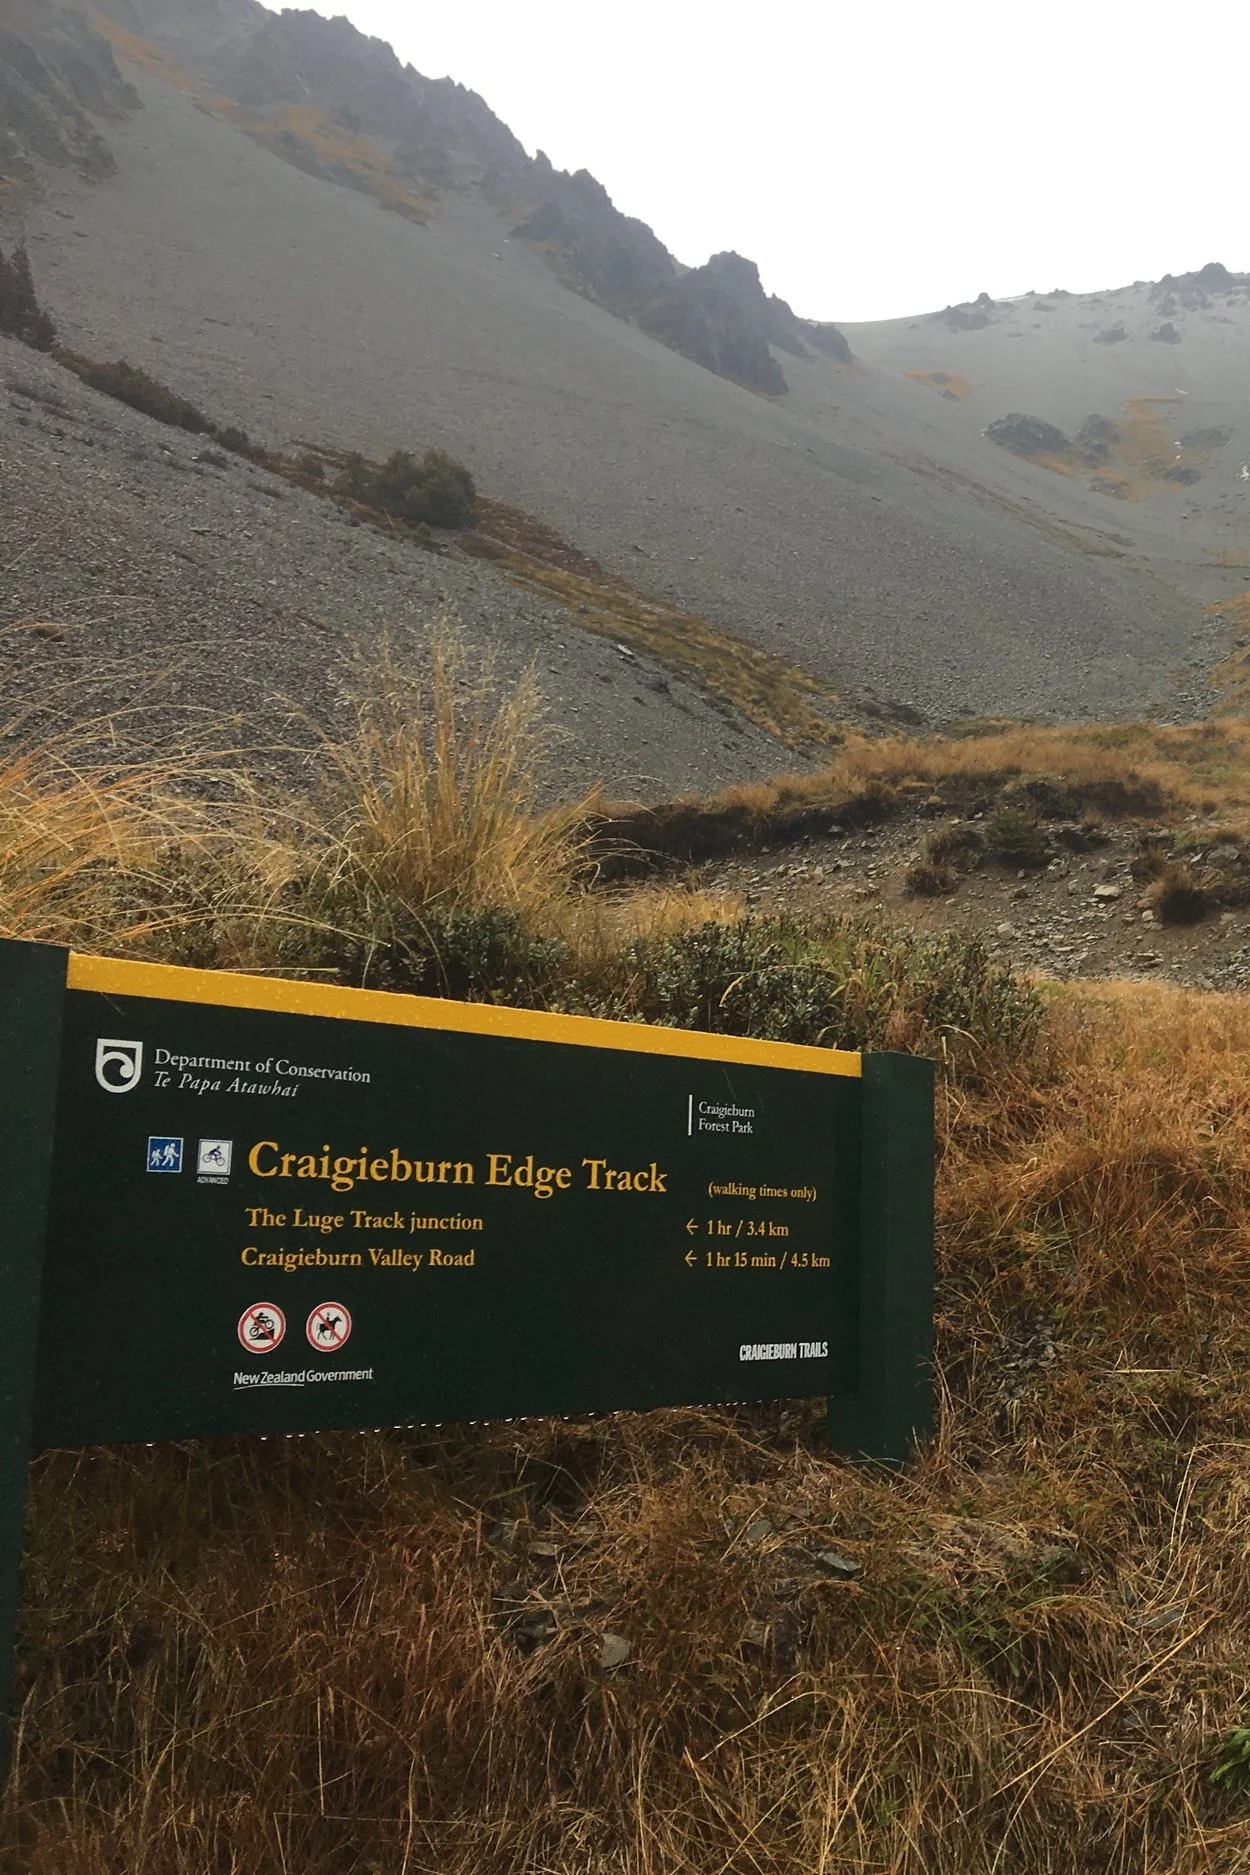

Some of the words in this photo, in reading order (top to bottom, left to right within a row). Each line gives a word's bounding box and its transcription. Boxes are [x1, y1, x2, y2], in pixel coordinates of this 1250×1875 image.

[154, 1048, 250, 1073] Department
[256, 1058, 274, 1073] of
[275, 1060, 370, 1084] Conservation
[154, 1070, 172, 1088] Te
[179, 1073, 220, 1095] Papa
[225, 1078, 300, 1098] Atawhai
[699, 1101, 755, 1118] Craigieburn
[699, 1118, 729, 1132] Forest
[732, 1121, 753, 1133] Park
[249, 1141, 474, 1192] Craigieburn
[485, 1154, 571, 1198] Edge
[582, 1158, 667, 1192] Track
[709, 1182, 756, 1200] (walking
[760, 1187, 788, 1197] times
[791, 1186, 816, 1202] only)
[245, 1208, 286, 1226] The
[292, 1209, 344, 1233] Luge
[350, 1211, 404, 1228] Track
[410, 1212, 482, 1233] junction
[707, 1219, 713, 1235] 1
[718, 1220, 732, 1235] hr
[735, 1220, 743, 1237] /
[747, 1221, 765, 1235] 3.4
[769, 1222, 788, 1236] km
[241, 1247, 361, 1272] Craigieburn
[368, 1248, 423, 1272] Valley
[429, 1249, 474, 1266] Road
[706, 1251, 713, 1267] 1
[717, 1252, 730, 1266] hr
[735, 1252, 747, 1267] 15
[751, 1253, 776, 1267] min
[780, 1252, 787, 1270] /
[791, 1253, 808, 1267] 4.5
[812, 1253, 830, 1267] km
[740, 1343, 797, 1361] CRAIGIEBURN
[799, 1342, 828, 1358] TRAILS
[260, 1370, 305, 1385] Zealand
[306, 1368, 373, 1382] Government
